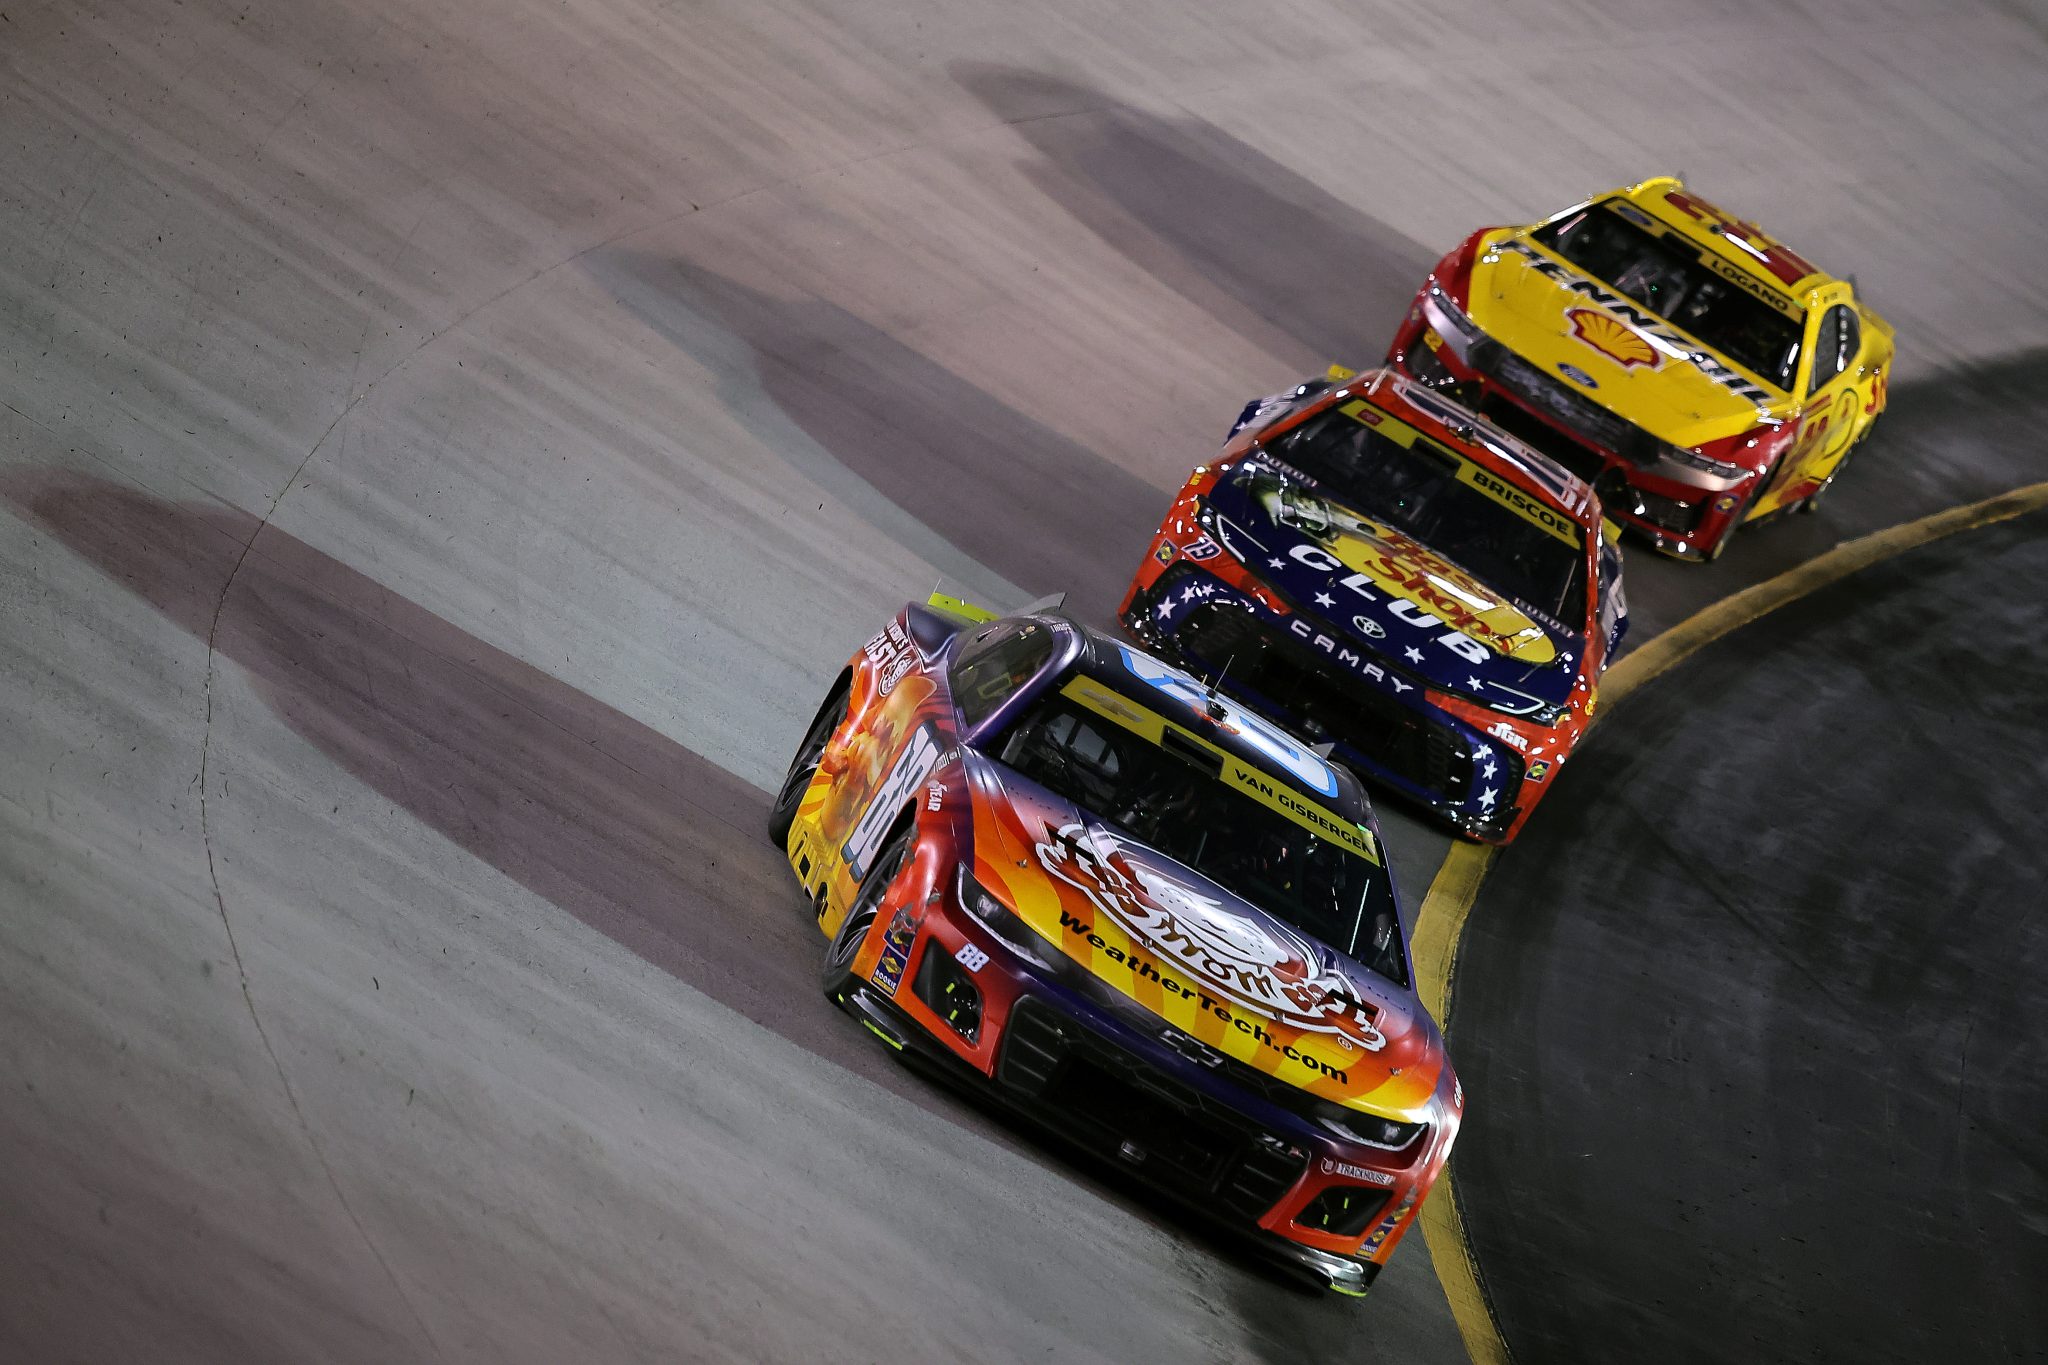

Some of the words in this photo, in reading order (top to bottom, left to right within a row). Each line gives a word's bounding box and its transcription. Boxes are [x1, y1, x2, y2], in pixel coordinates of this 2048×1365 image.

[1711, 260, 1789, 311] LOGANO
[1472, 471, 1569, 536] BRISCOE
[1288, 544, 1491, 665] CLUB
[1290, 619, 1414, 693] CAMRY
[1487, 722, 1529, 752] JGR
[1234, 768, 1274, 798] VAN
[875, 968, 897, 991] ROOKIE
[954, 942, 990, 974] 88
[1058, 910, 1348, 1085] WeatherTech.com
